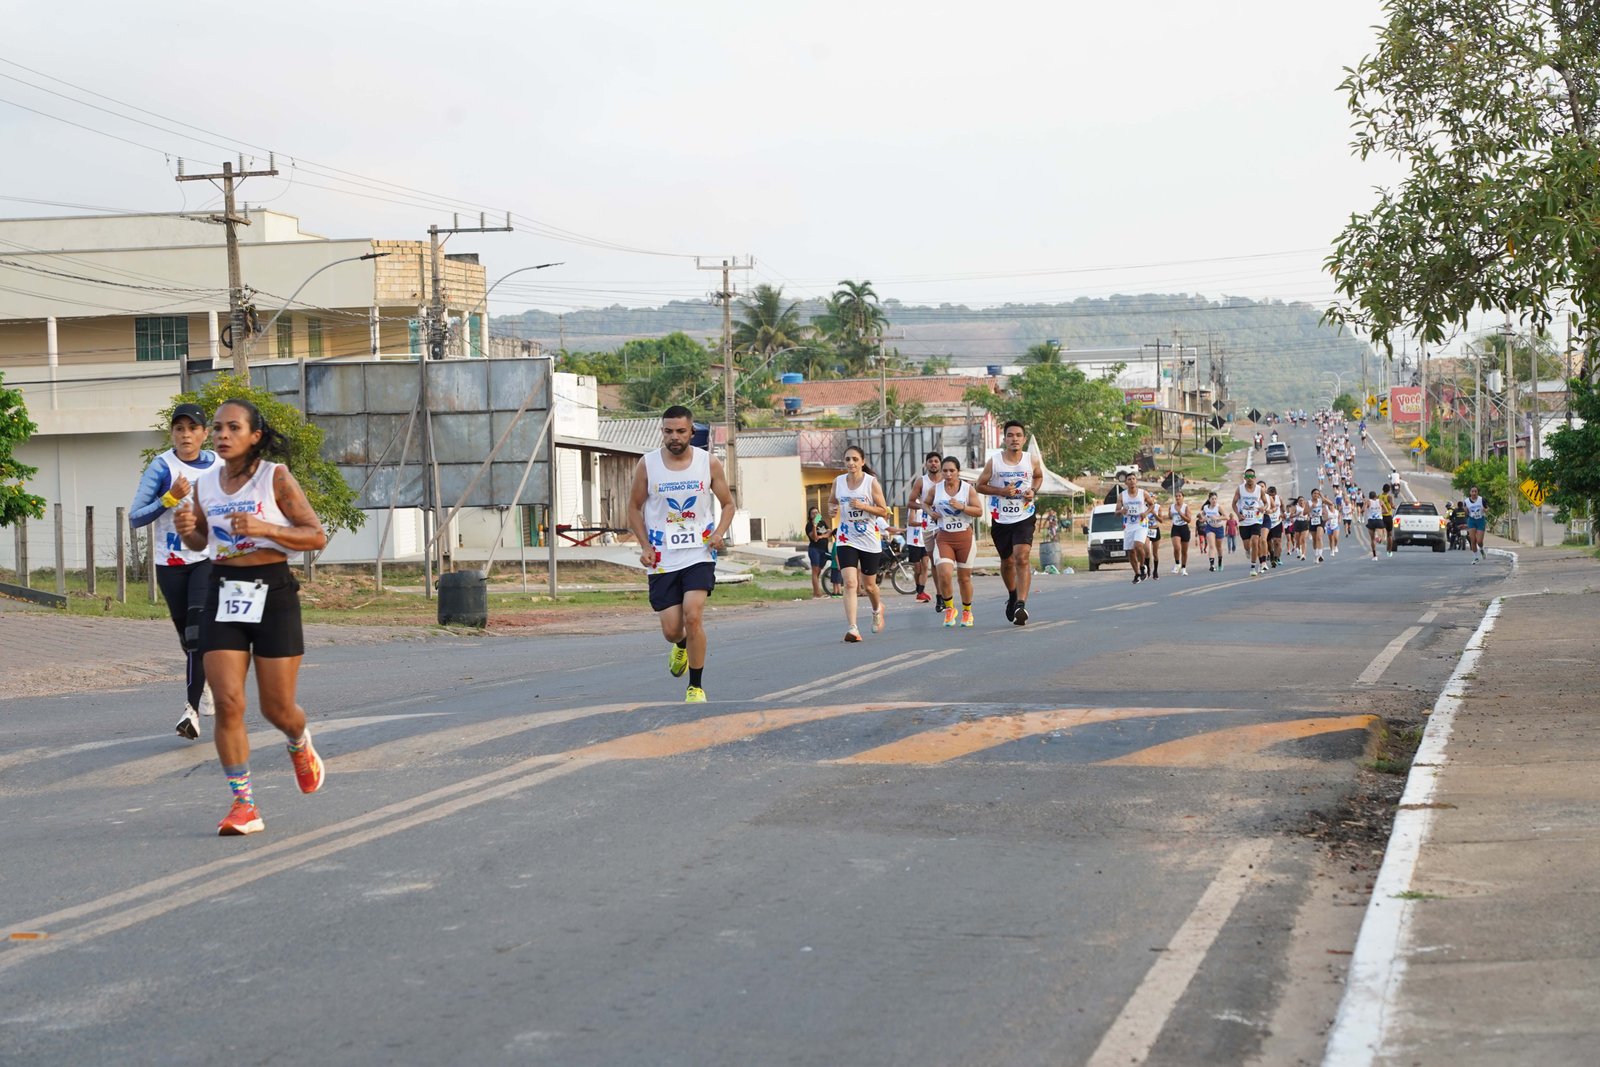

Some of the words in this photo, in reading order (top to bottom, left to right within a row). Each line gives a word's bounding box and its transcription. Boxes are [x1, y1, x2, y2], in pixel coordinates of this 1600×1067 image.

[658, 485, 686, 493] AUTISMO
[848, 510, 864, 518] 167
[946, 522, 963, 530] 070
[671, 533, 696, 545] 021
[225, 600, 253, 615] 157
